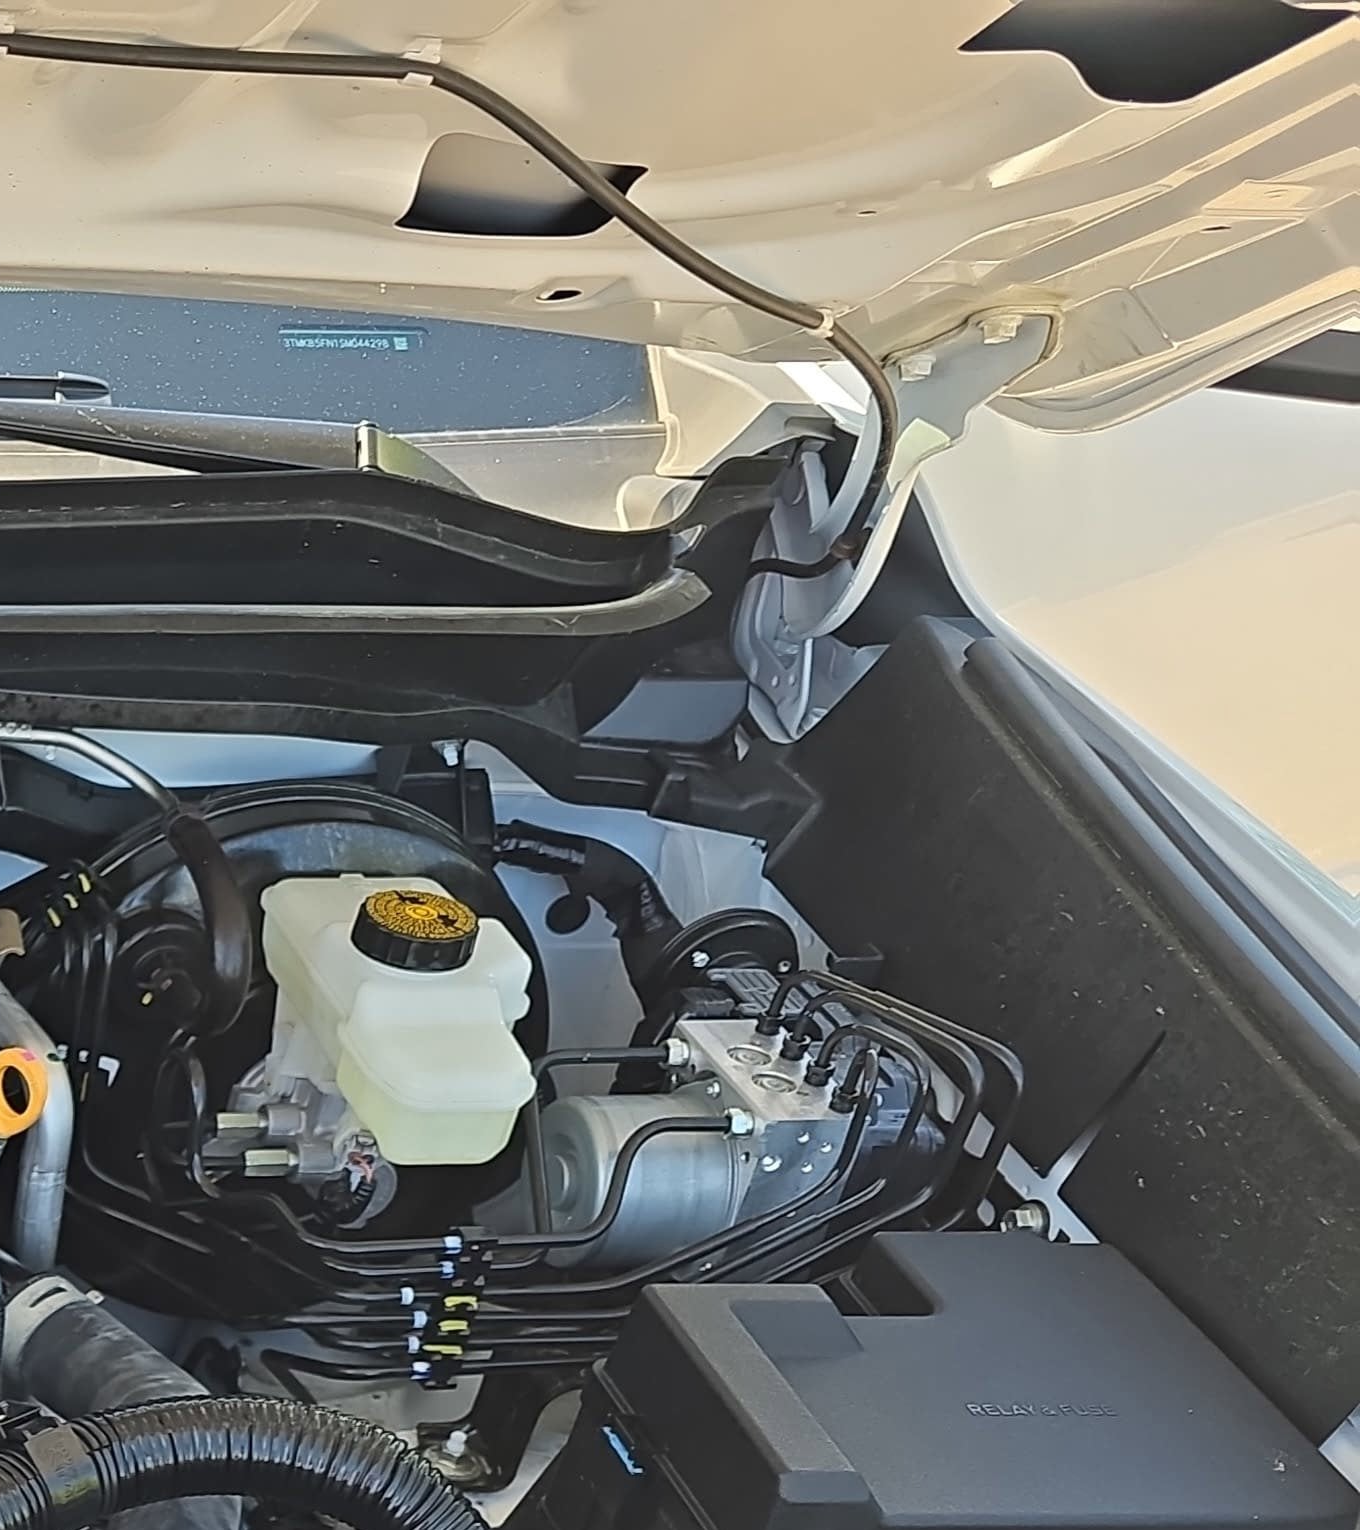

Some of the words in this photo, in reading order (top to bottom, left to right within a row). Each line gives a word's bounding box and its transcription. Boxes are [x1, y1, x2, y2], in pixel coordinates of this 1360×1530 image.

[966, 1402, 1037, 1418] RELAY
[1040, 1402, 1056, 1417] &
[1058, 1402, 1119, 1418] FUSE
